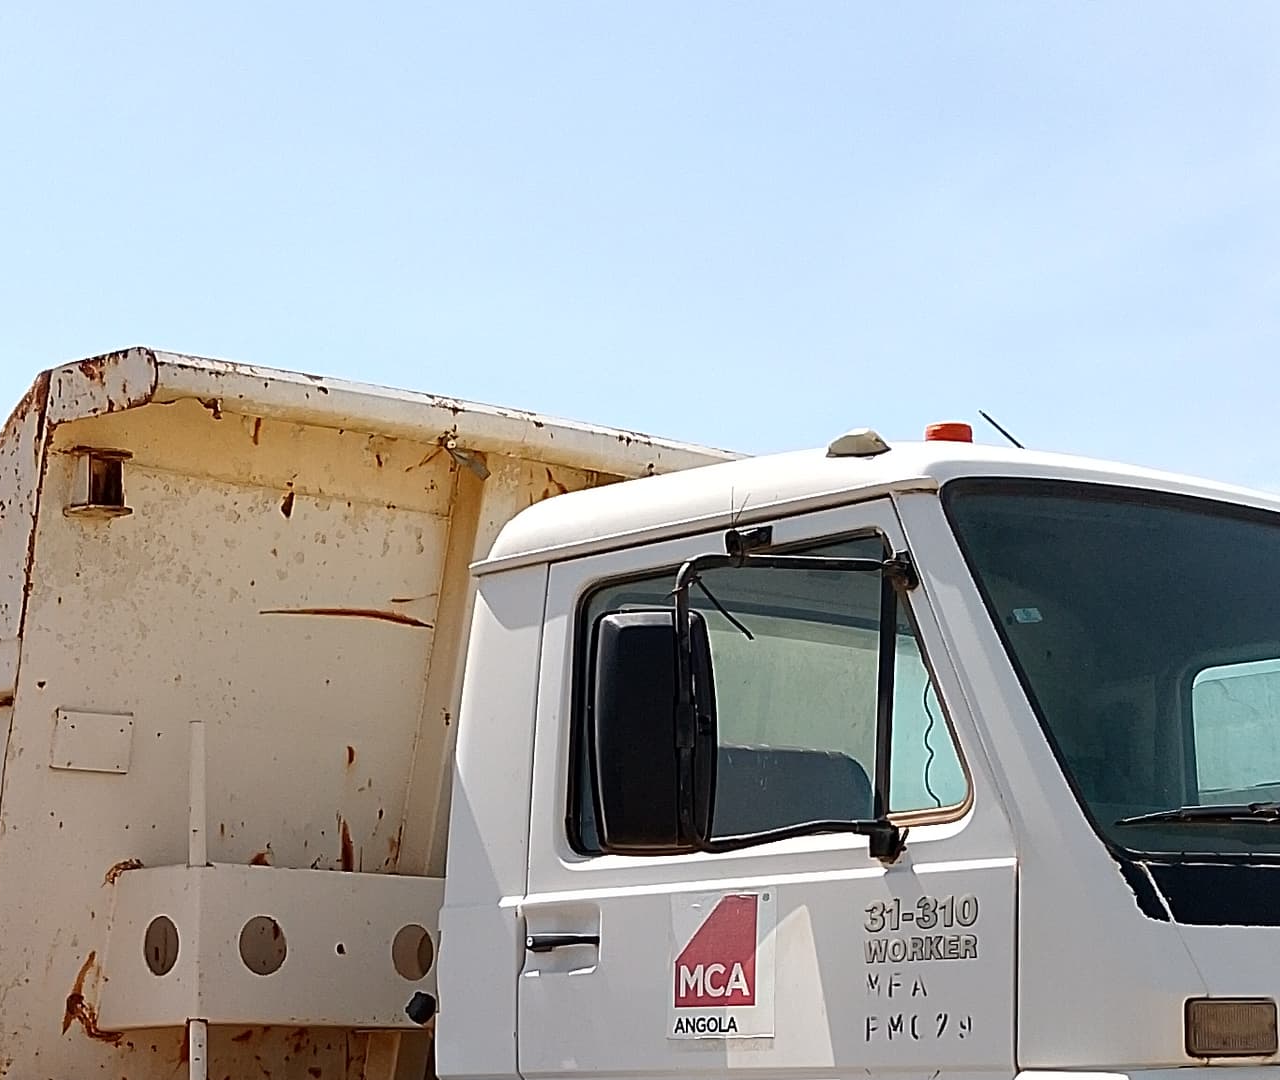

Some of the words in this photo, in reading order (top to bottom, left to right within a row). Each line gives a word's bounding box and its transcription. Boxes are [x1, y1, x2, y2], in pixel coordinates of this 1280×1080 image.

[863, 895, 979, 933] 31-310
[863, 934, 978, 964] WORKER
[679, 962, 751, 998] MCA
[674, 1017, 738, 1034] ANGOLA
